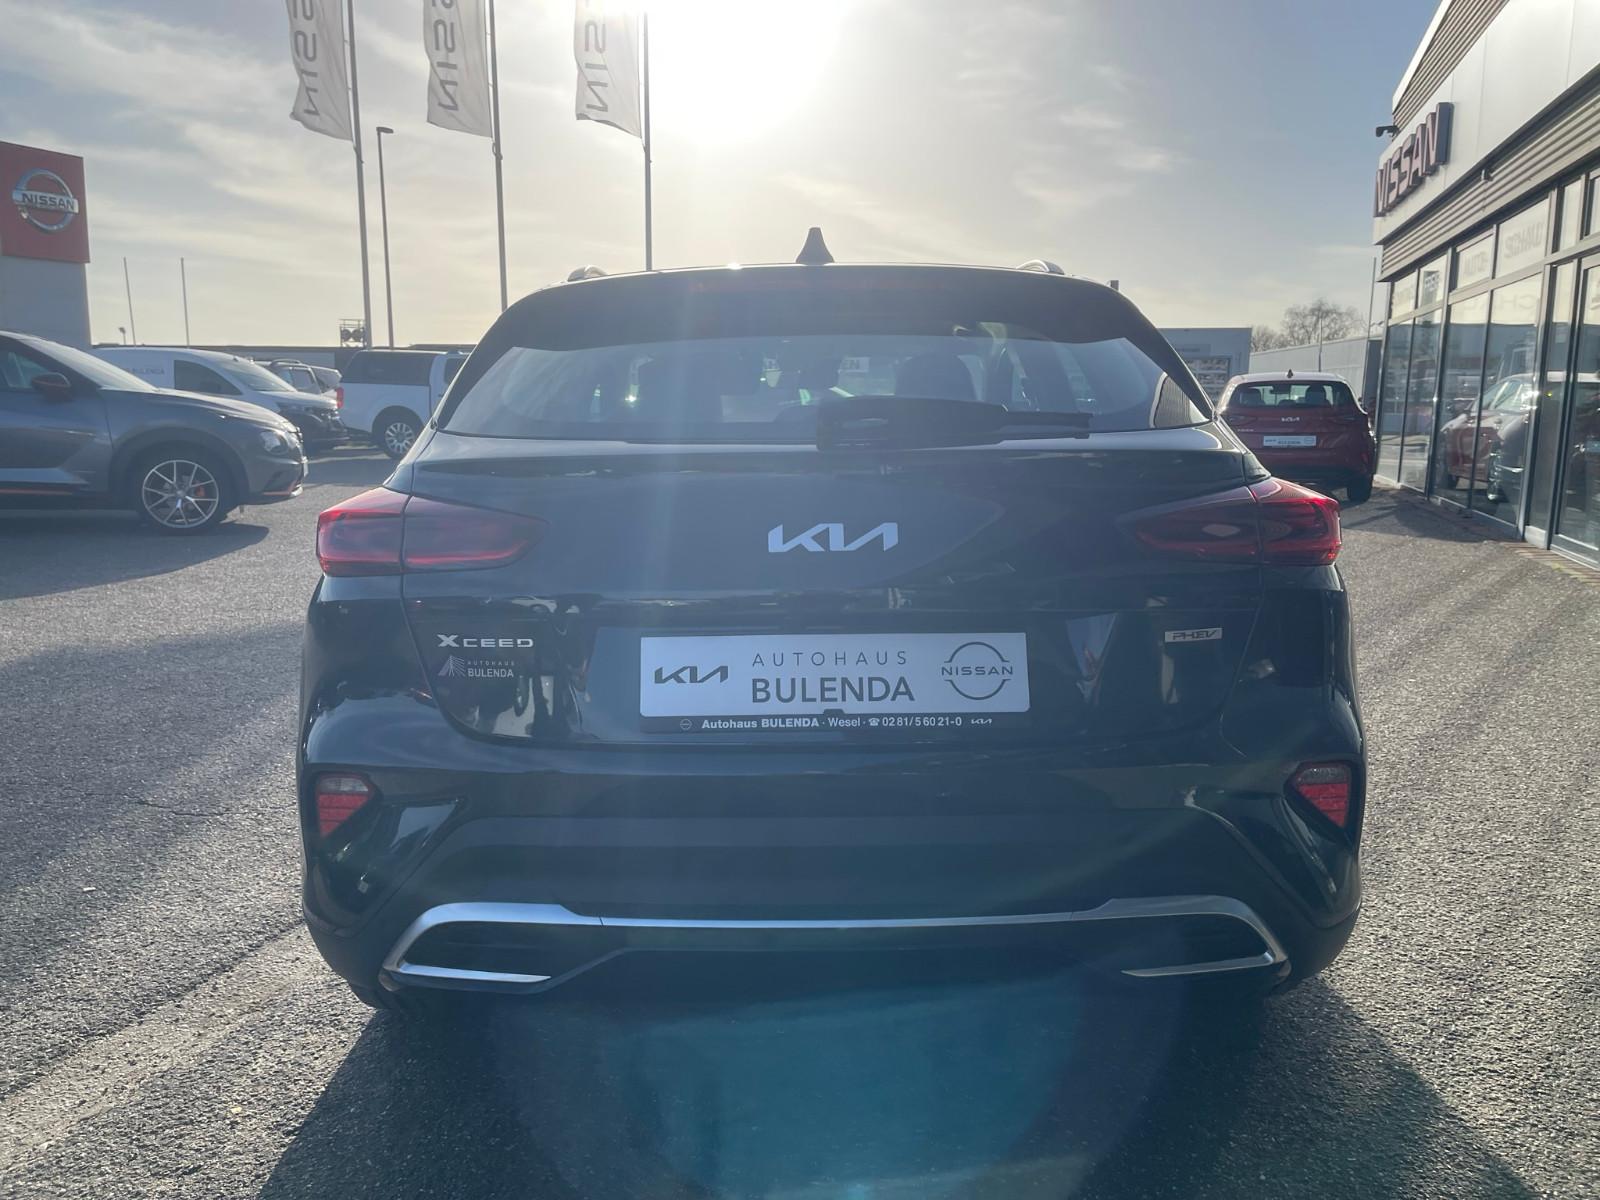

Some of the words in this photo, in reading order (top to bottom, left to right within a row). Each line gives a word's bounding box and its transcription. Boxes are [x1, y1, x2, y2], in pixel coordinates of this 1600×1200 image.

[1374, 102, 1453, 217] NISSAN
[22, 193, 75, 210] NISSAN
[768, 522, 898, 552] KIA
[437, 634, 534, 648] XCEED
[1173, 630, 1217, 640] PHEV
[752, 651, 907, 667] AUTOHAUS
[467, 668, 514, 678] BULENDA
[654, 666, 728, 684] KIA
[941, 666, 1013, 676] NISSAN
[752, 676, 916, 703] BULENDA
[702, 719, 757, 729] Autohaus
[761, 718, 819, 728] BULENDA
[828, 717, 860, 727] Wesel
